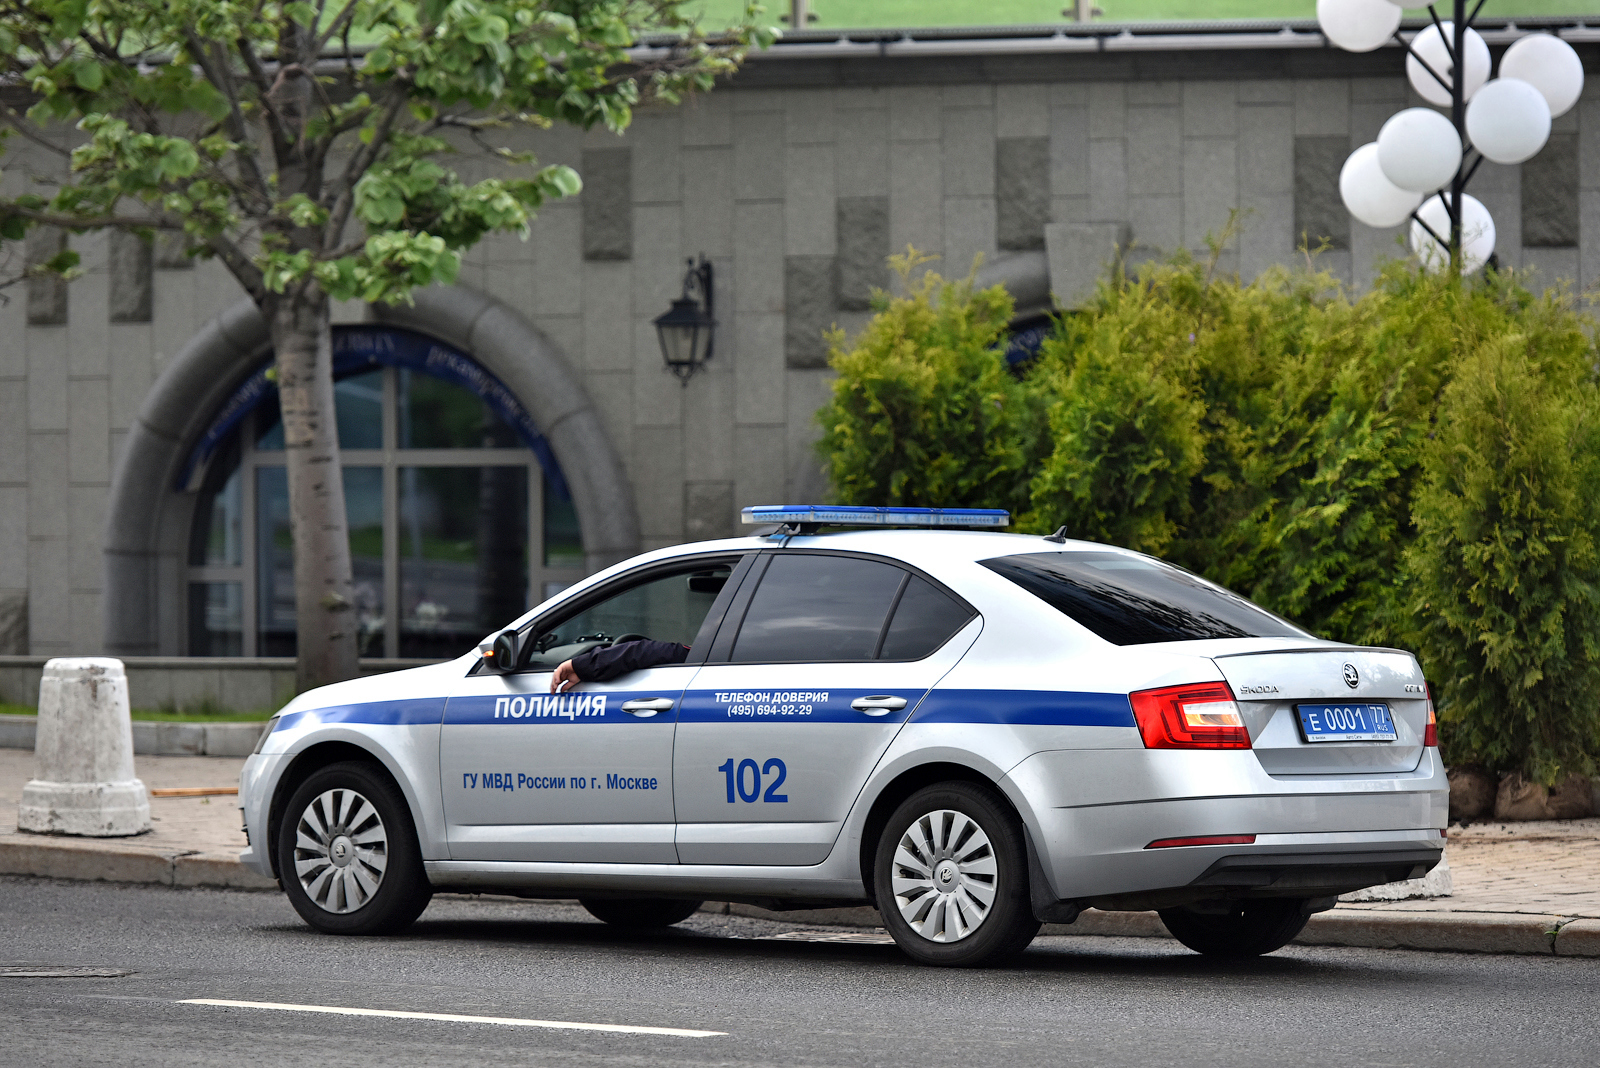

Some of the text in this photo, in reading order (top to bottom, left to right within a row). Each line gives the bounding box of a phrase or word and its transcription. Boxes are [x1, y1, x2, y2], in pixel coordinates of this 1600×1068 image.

[714, 692, 829, 704] ТЕЛЕФОН ДОВЕРИЯ
[494, 695, 607, 721] ПОЛИЦИЯ
[727, 705, 813, 717] (495) 694-92-29
[1369, 706, 1385, 724] 77
[1324, 707, 1367, 731] 0001
[1376, 724, 1389, 732] RUS
[463, 773, 658, 791] ГУ МВД России по г. Москве
[718, 758, 788, 803] 102
